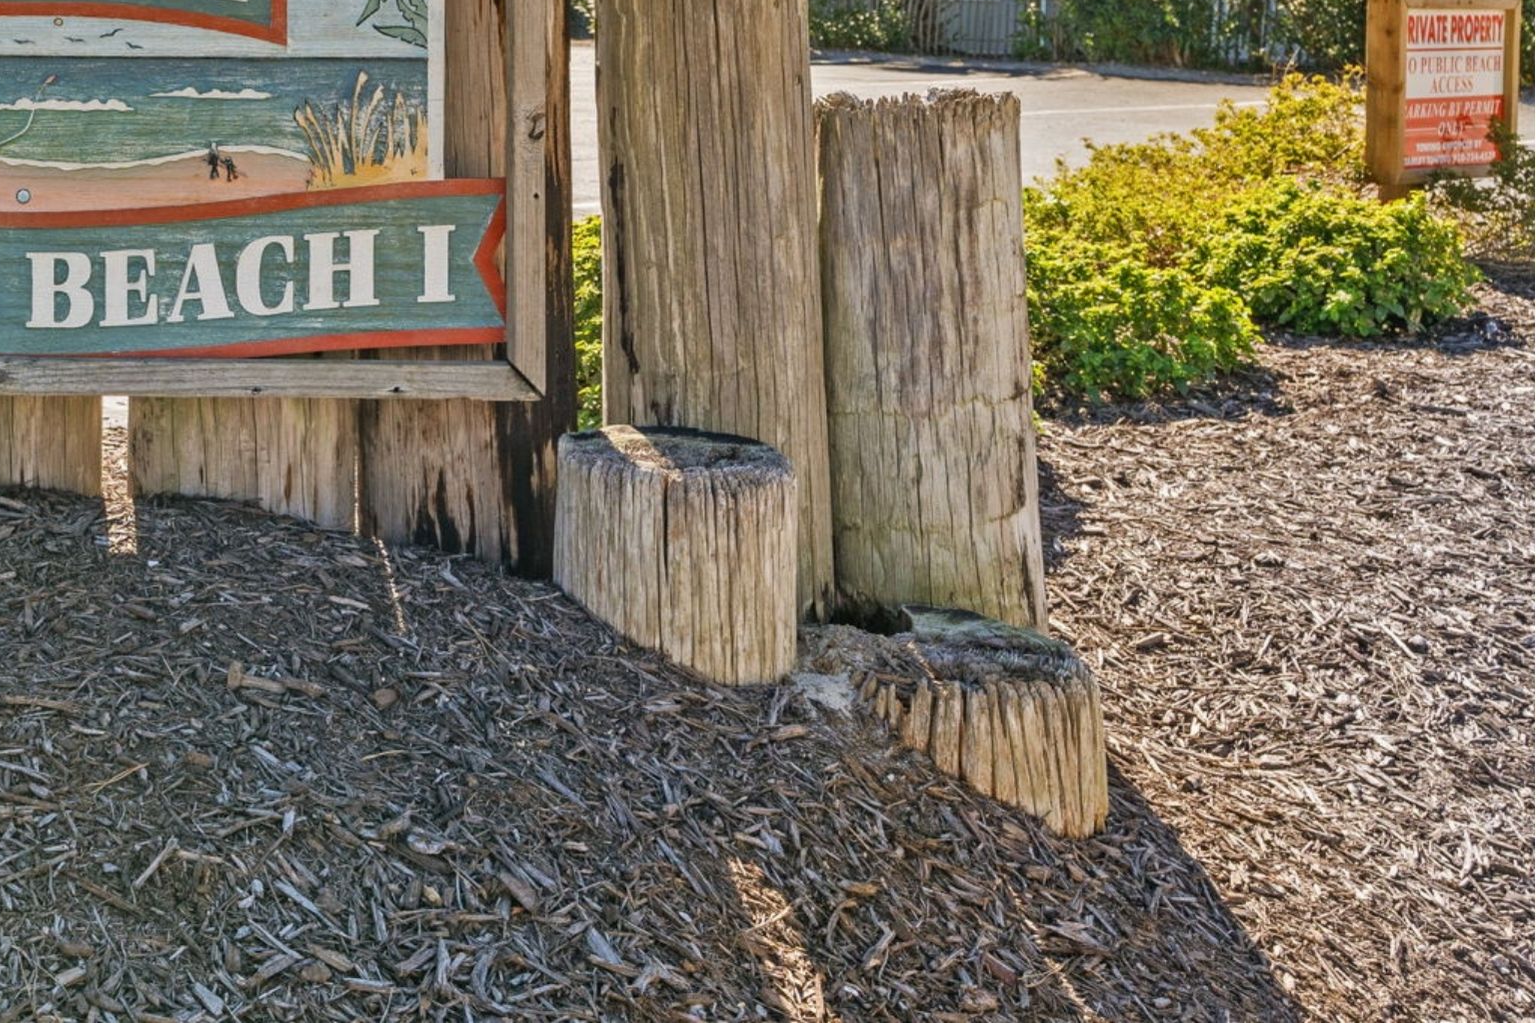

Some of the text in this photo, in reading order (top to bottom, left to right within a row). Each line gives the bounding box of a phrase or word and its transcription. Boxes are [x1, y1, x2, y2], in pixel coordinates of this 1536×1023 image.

[1451, 14, 1504, 44] PROPERTY
[1421, 57, 1463, 75] PUBLIC
[1466, 55, 1501, 73] BEACH
[1430, 76, 1474, 95] ACCESS
[1404, 102, 1447, 121] ARKING
[1463, 99, 1501, 117] PERMIT
[24, 228, 382, 330] BEACH
[415, 224, 457, 305] I
